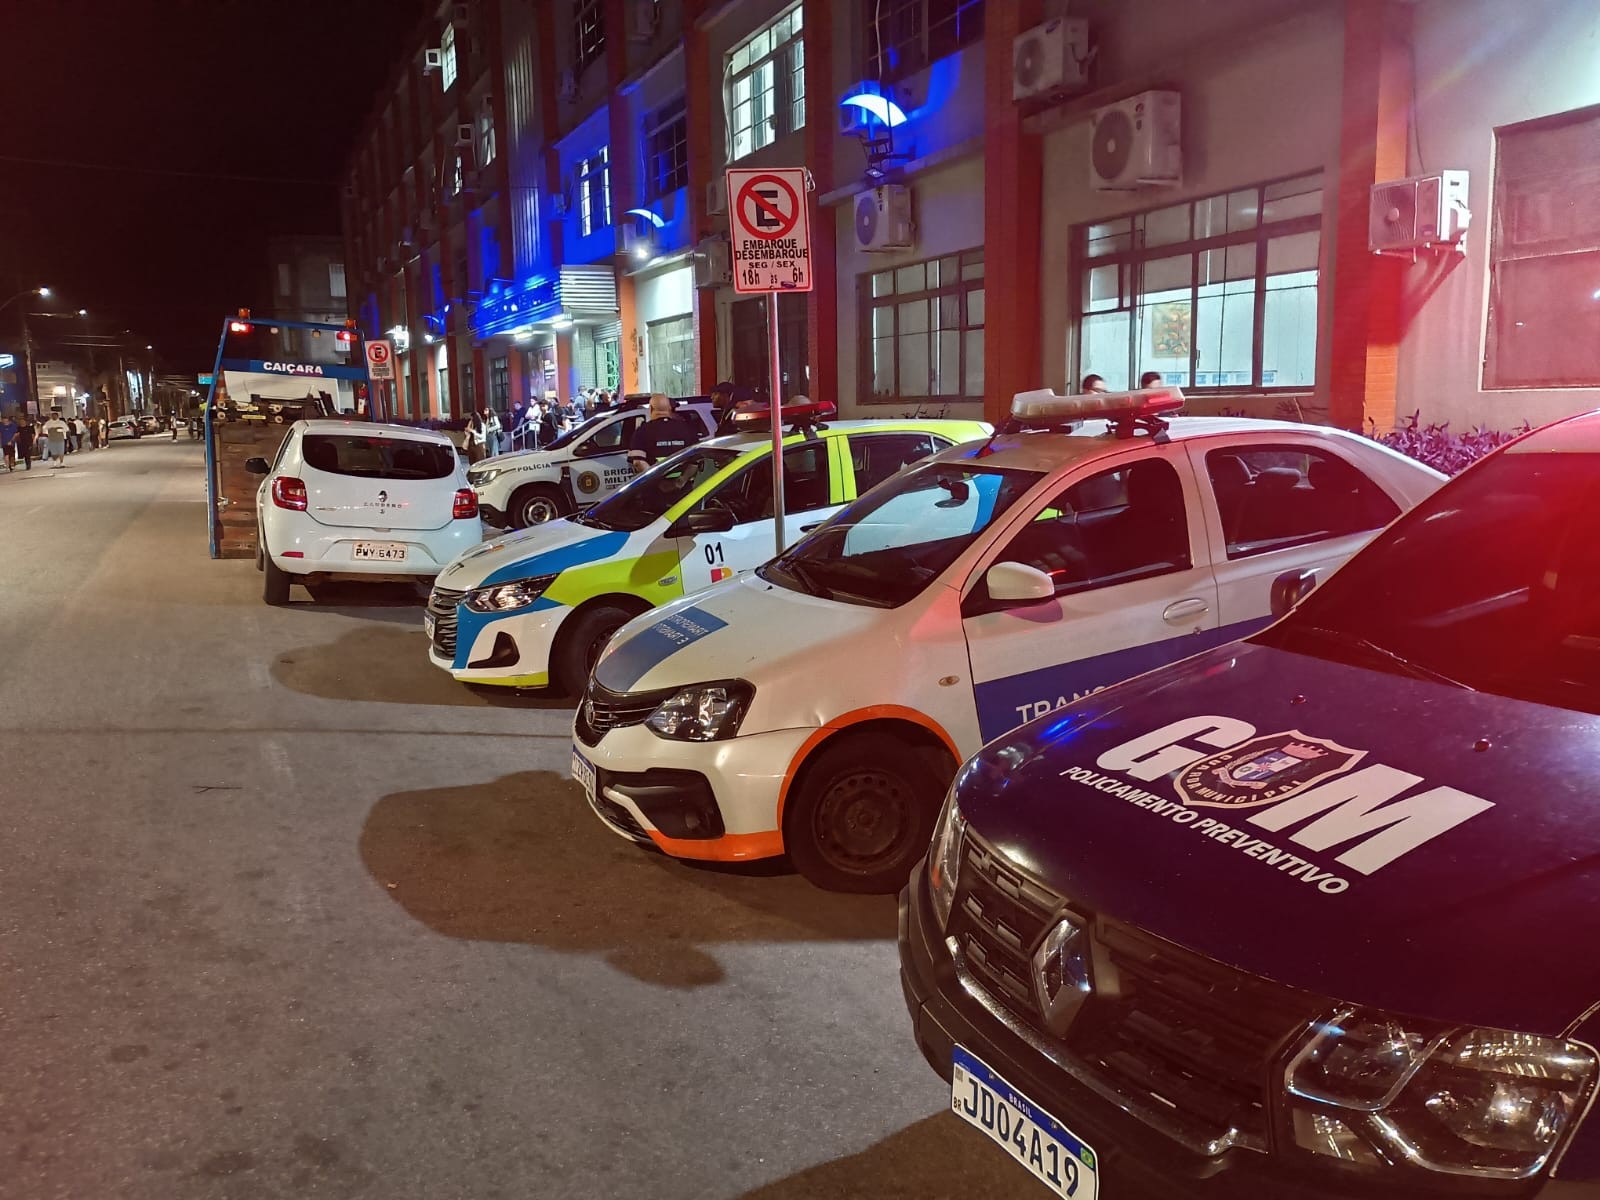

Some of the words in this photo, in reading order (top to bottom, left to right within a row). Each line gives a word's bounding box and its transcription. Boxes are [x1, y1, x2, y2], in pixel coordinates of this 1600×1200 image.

[743, 239, 797, 250] EMBARQUE
[735, 248, 808, 261] DESEMBARQUE
[748, 261, 768, 269] SEG
[776, 260, 796, 268] SEX
[742, 269, 760, 285] 18h
[792, 267, 804, 283] 6h
[263, 361, 324, 375] CAIÇARA
[517, 462, 551, 473] POLÍCIA
[704, 541, 725, 565] 01
[1186, 754, 1234, 790] GUARDA
[1194, 779, 1304, 804] MUNICIPAL
[1059, 765, 1200, 830] POLICIAMENTO
[1192, 817, 1350, 895] PREVENTIVO
[953, 1096, 962, 1112] BR
[1008, 1093, 1033, 1119] BRASIL
